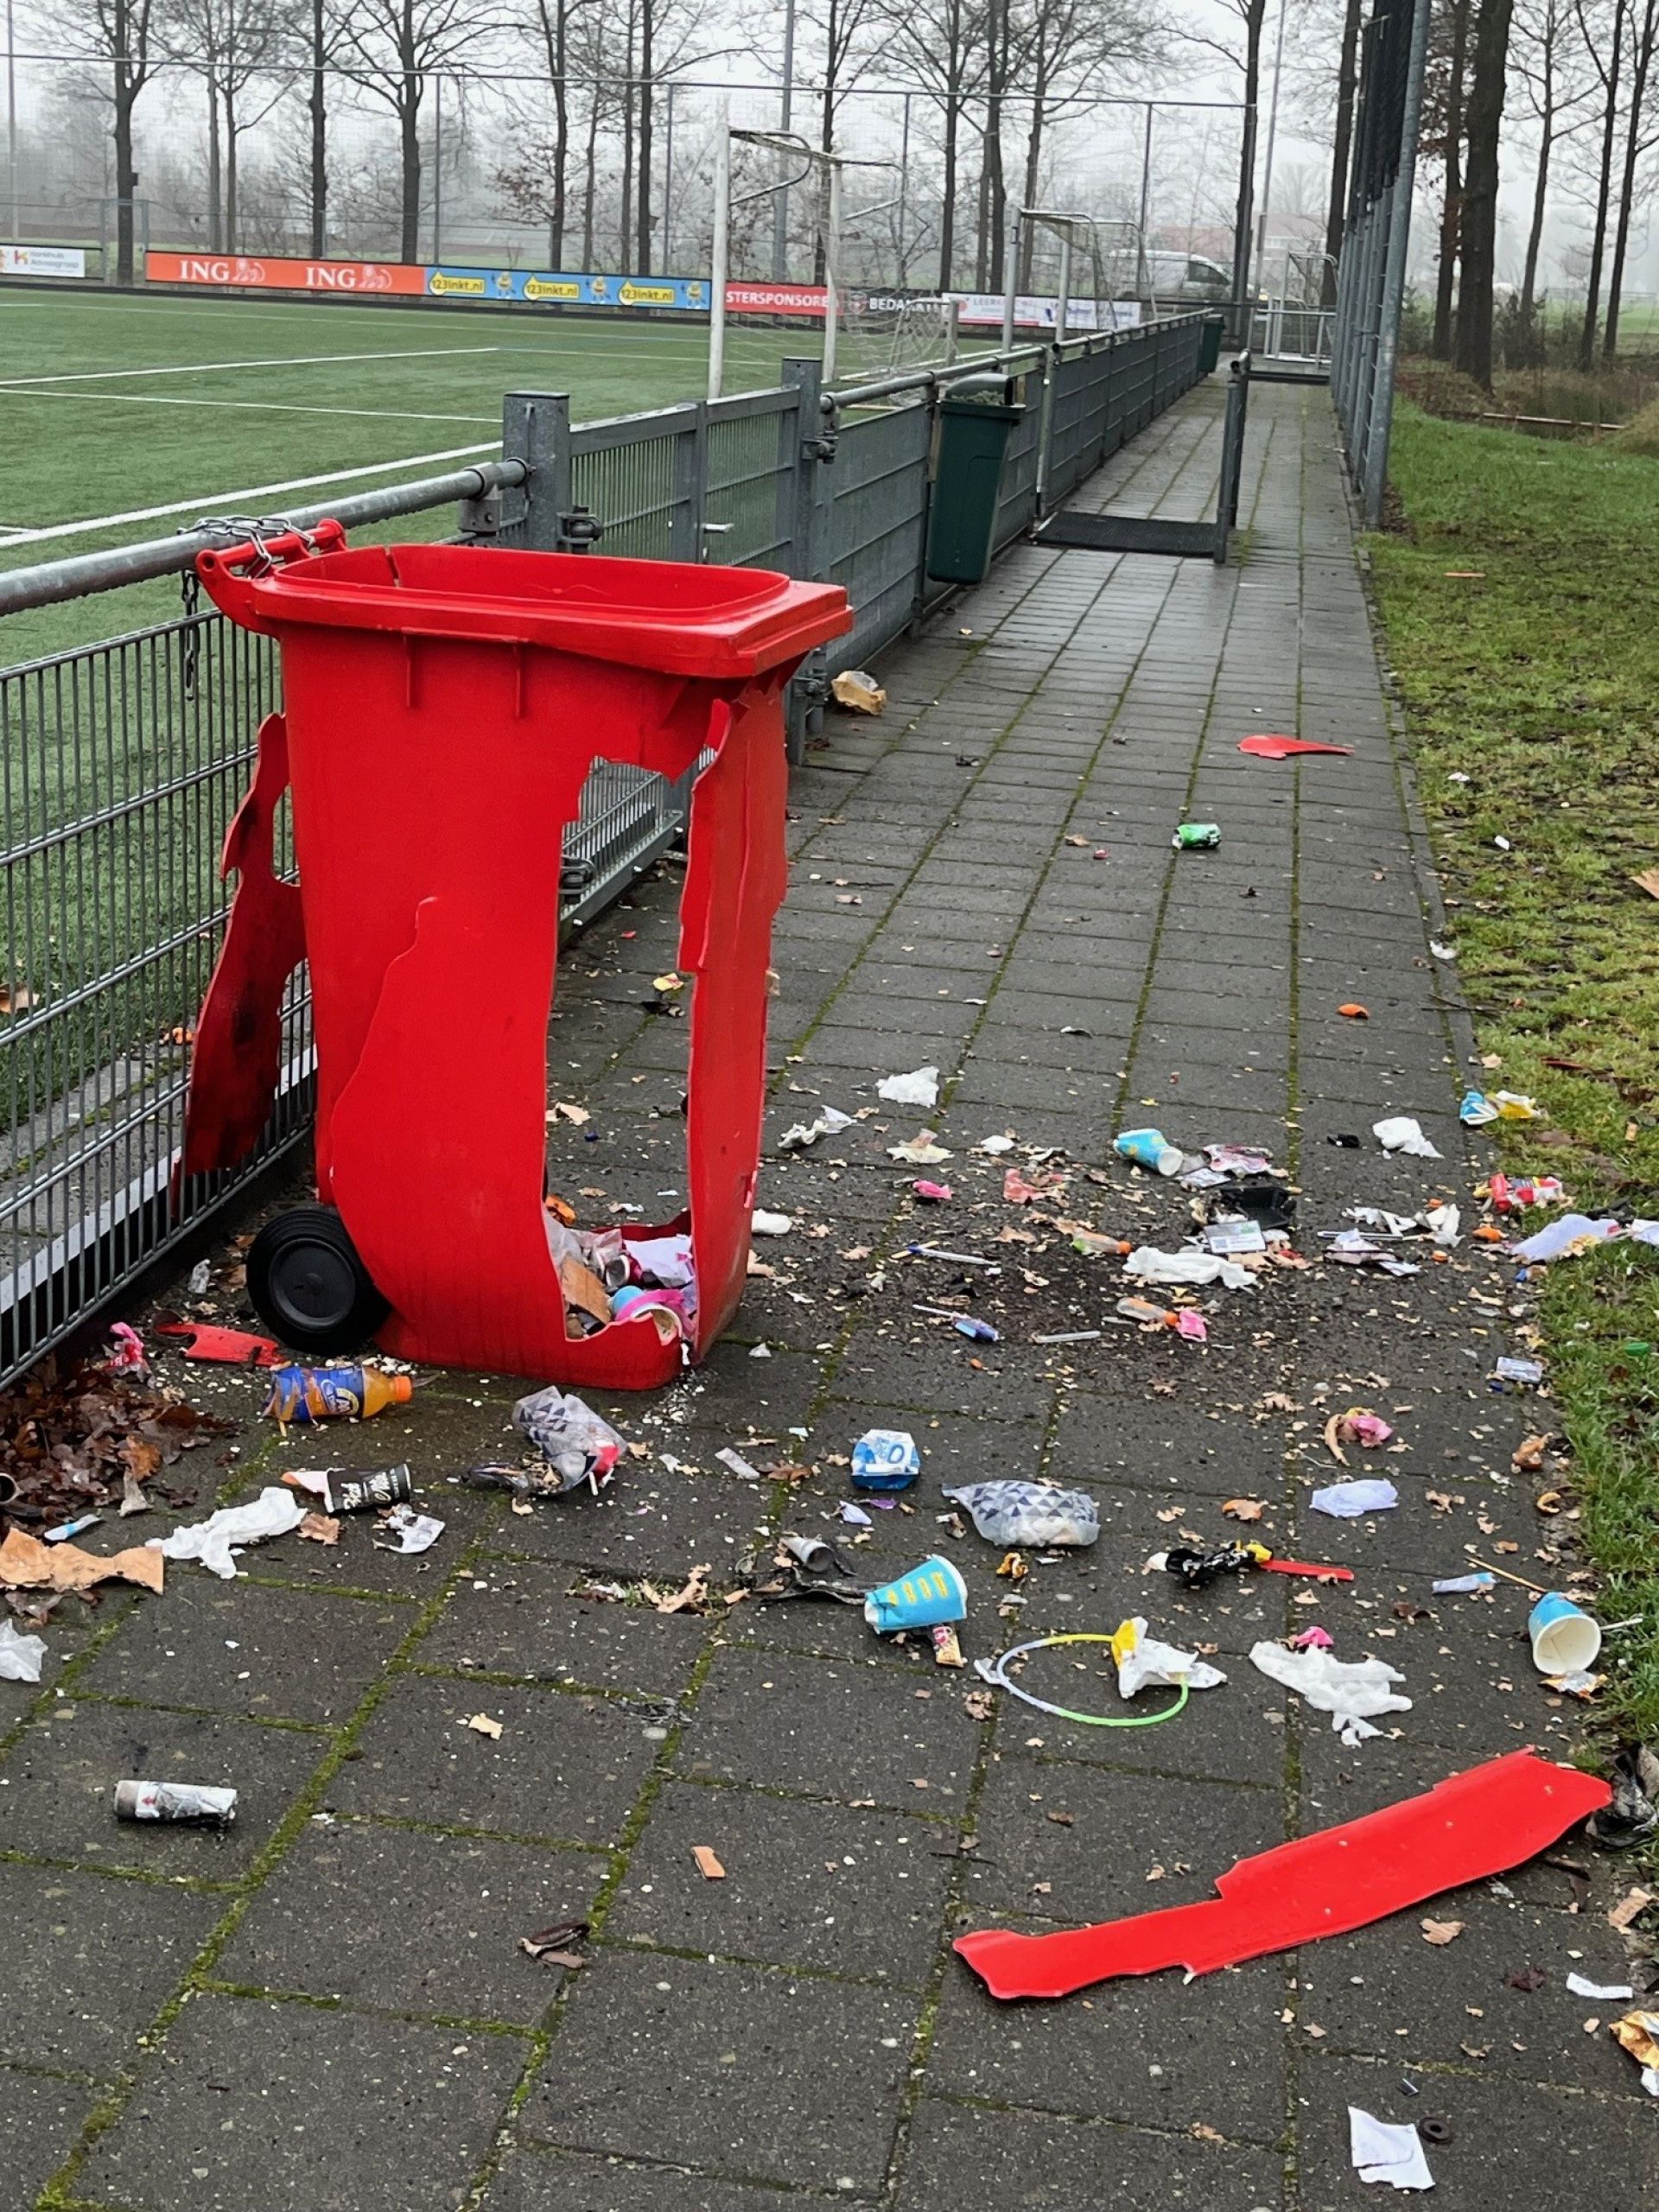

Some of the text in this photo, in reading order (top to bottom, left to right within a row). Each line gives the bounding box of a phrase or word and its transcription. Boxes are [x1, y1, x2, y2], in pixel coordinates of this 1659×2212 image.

[180, 260, 230, 282] ING
[306, 266, 356, 288] ING
[433, 279, 483, 291] 123inkt.nl
[526, 284, 577, 296] 123inkt.nl
[621, 289, 673, 301] 123inkt.nl
[726, 291, 838, 307] STERSPONSORE
